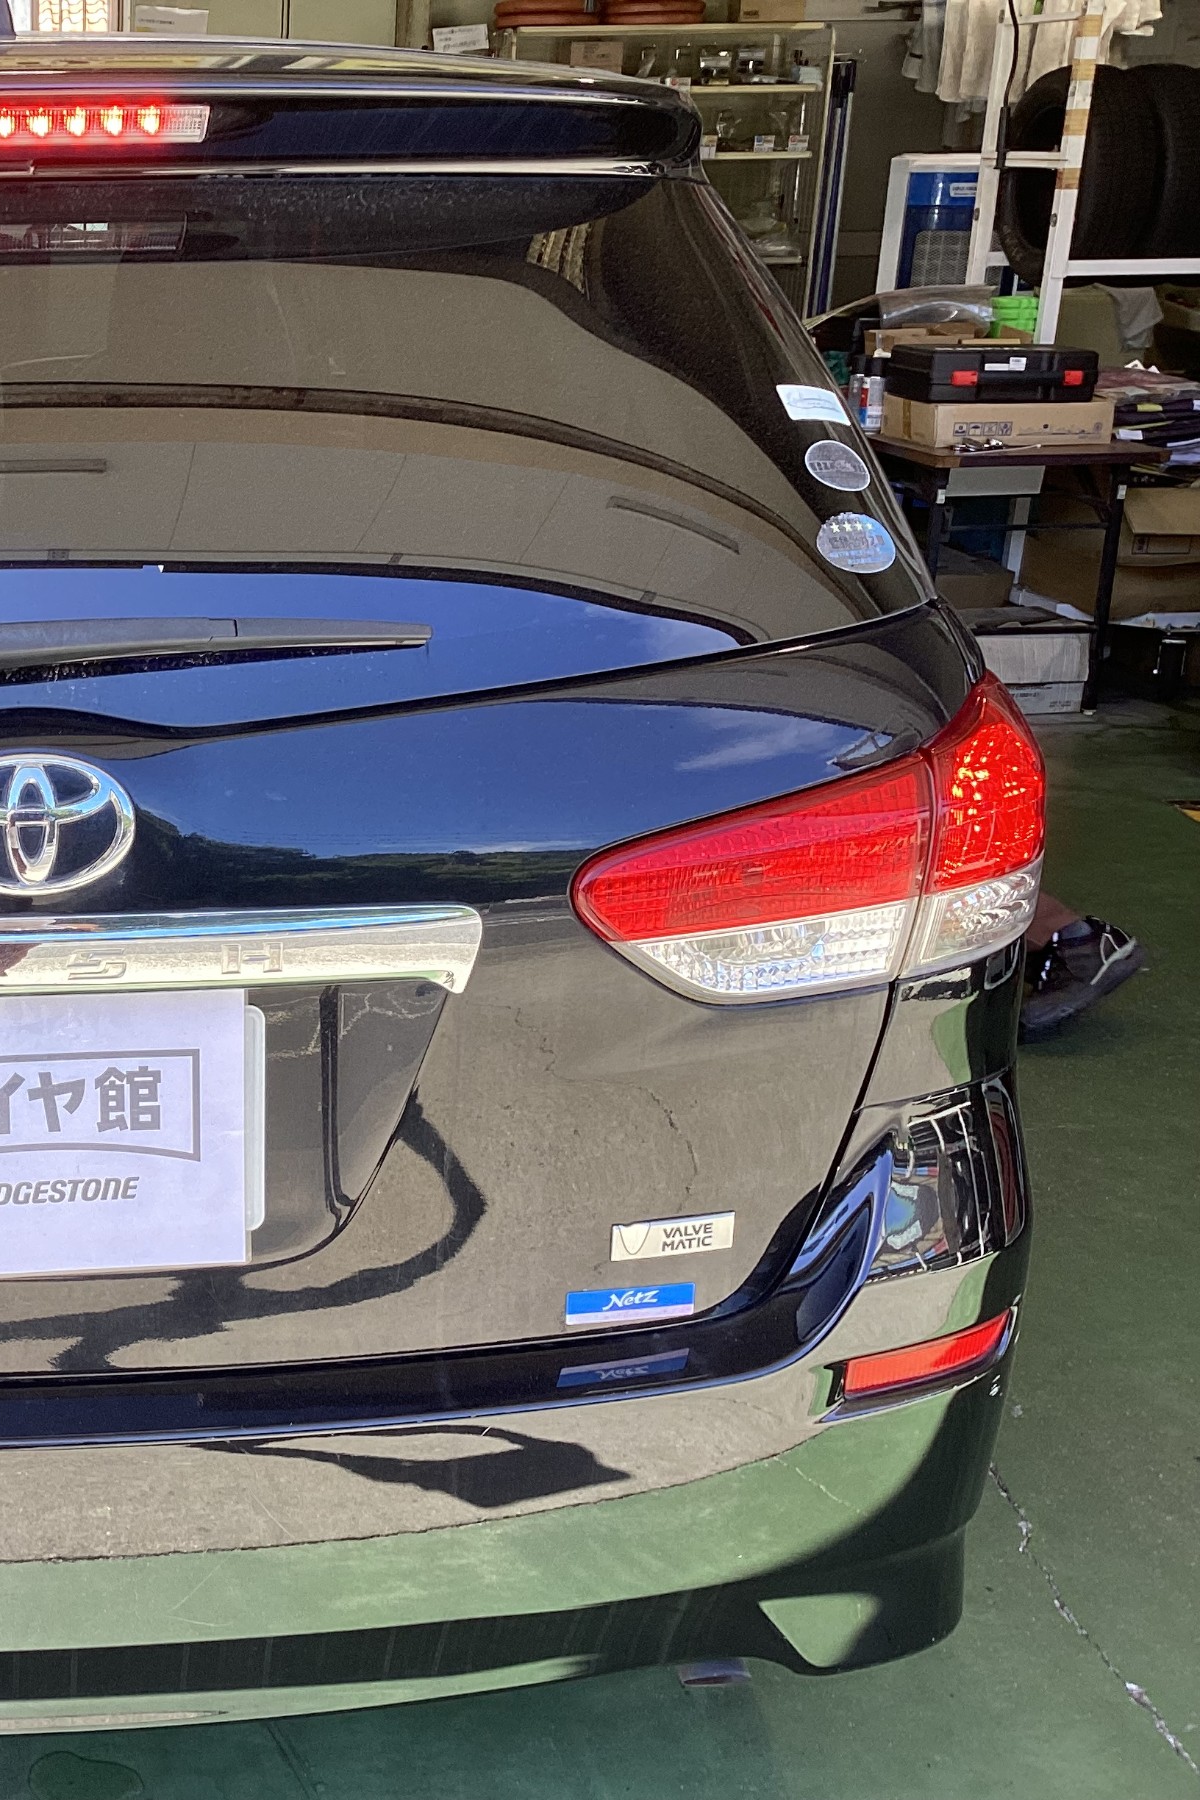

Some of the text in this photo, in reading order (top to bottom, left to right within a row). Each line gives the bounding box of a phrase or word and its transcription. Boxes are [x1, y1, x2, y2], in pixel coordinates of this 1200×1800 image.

[663, 1222, 713, 1238] VALVE
[661, 1236, 713, 1252] MATIC
[602, 1289, 660, 1312] Netz
